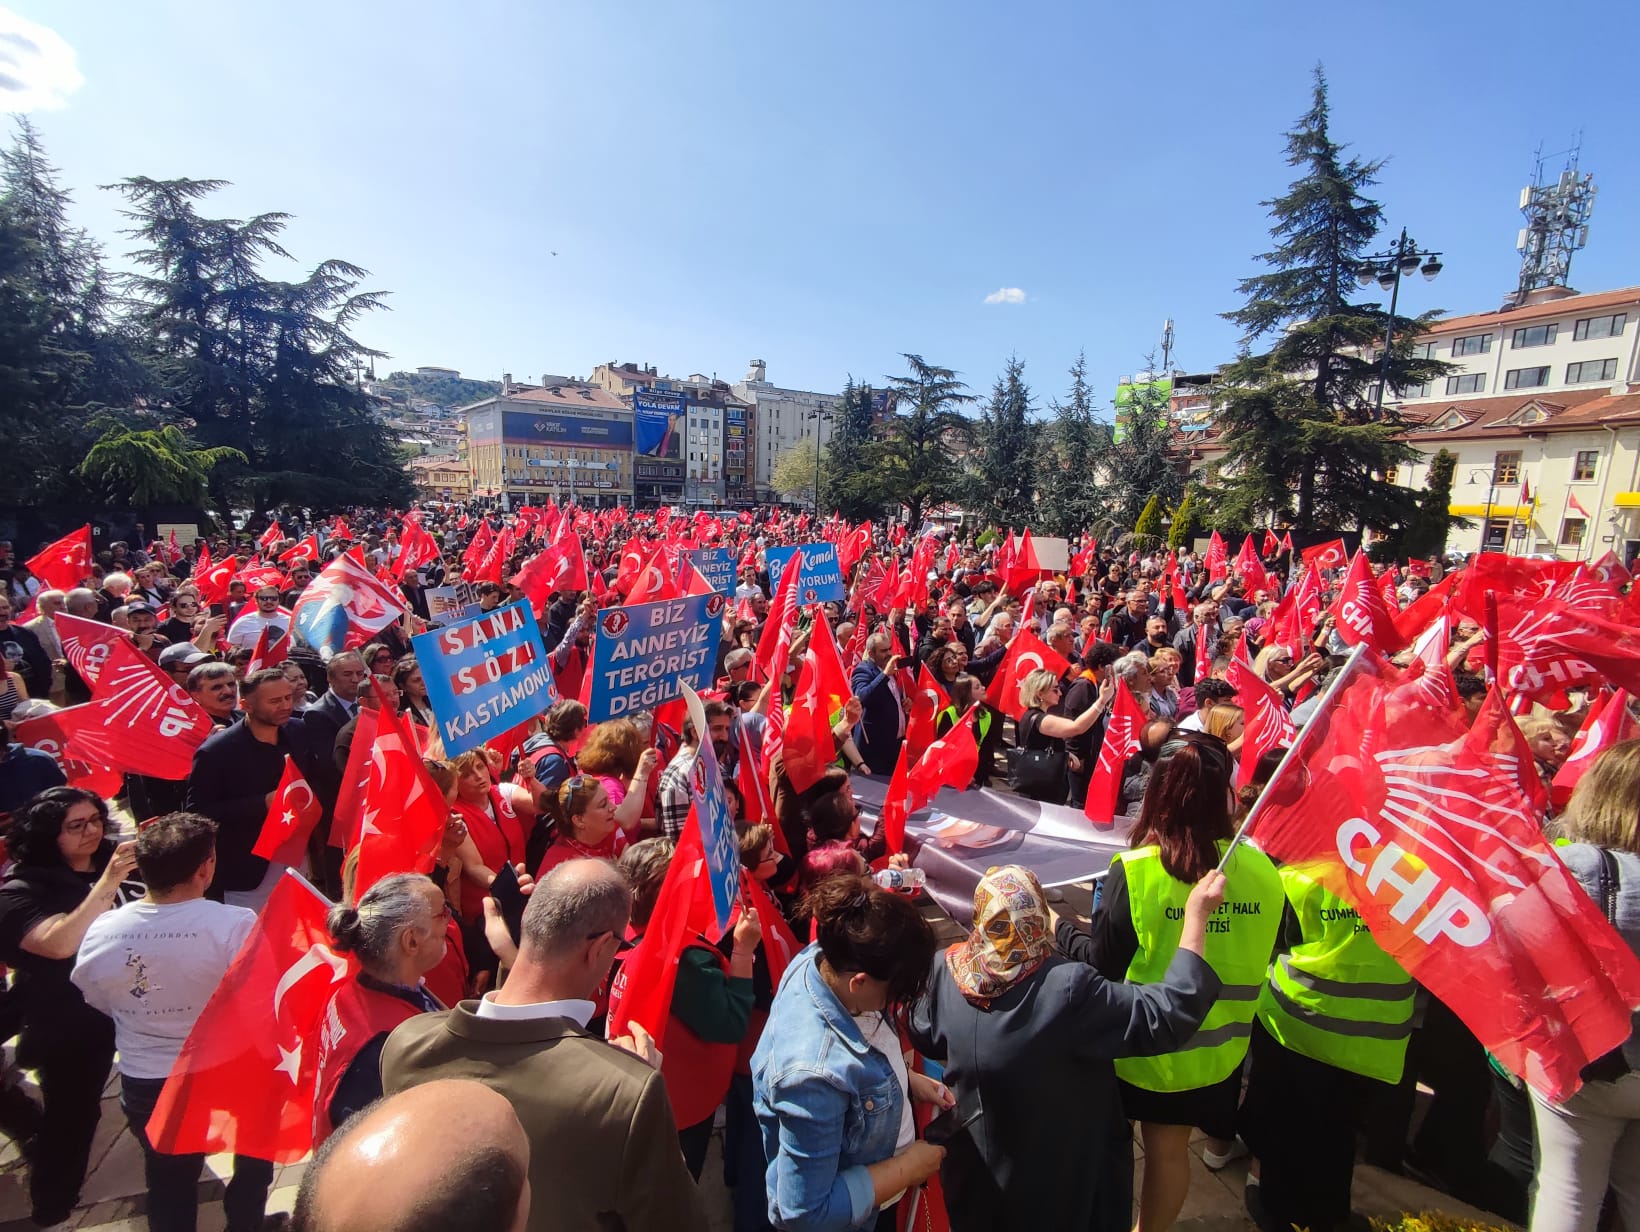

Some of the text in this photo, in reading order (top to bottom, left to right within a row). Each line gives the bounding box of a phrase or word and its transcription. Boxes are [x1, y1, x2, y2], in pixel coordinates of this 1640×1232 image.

[697, 560, 731, 573] NEYİZ
[800, 544, 834, 571] Kemal
[706, 574, 732, 585] ÖRİST
[445, 606, 524, 656] SANA
[650, 601, 686, 627] BİZ
[610, 621, 710, 662] ANNEYİZ
[458, 641, 534, 694] SÖZ!
[605, 647, 710, 690] TERÖRİST
[445, 663, 550, 742] KASTAMONU
[1336, 818, 1492, 947] CHP
[1205, 917, 1231, 933] TİSİ
[1232, 902, 1261, 915] HALK
